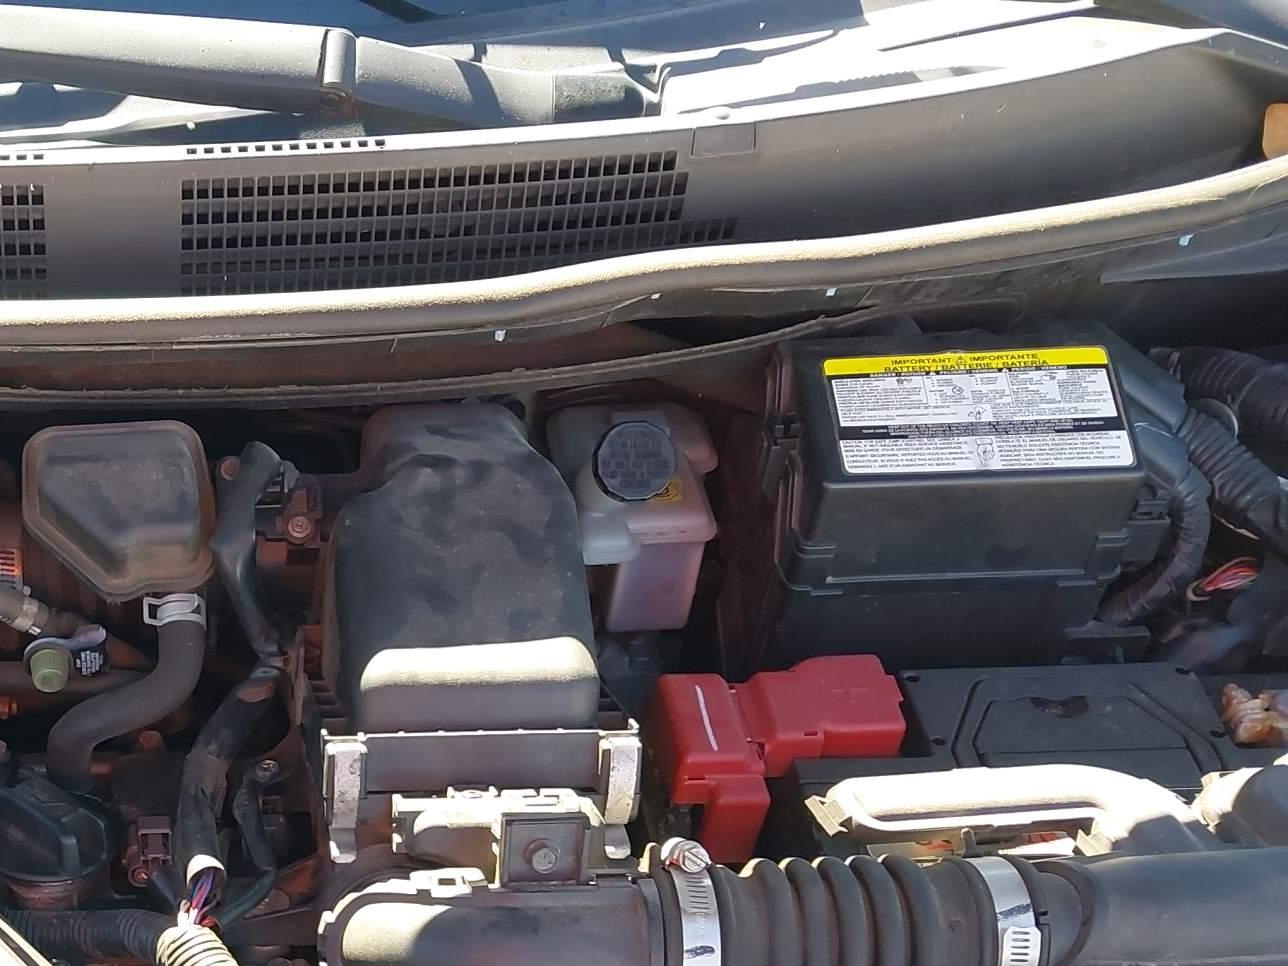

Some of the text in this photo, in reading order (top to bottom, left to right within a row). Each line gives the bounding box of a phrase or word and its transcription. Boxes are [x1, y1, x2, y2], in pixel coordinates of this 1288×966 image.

[891, 353, 1039, 366] IMPORTANT IMPORTANTE
[884, 365, 934, 373] BATTERY
[941, 362, 994, 370] BATTERIE
